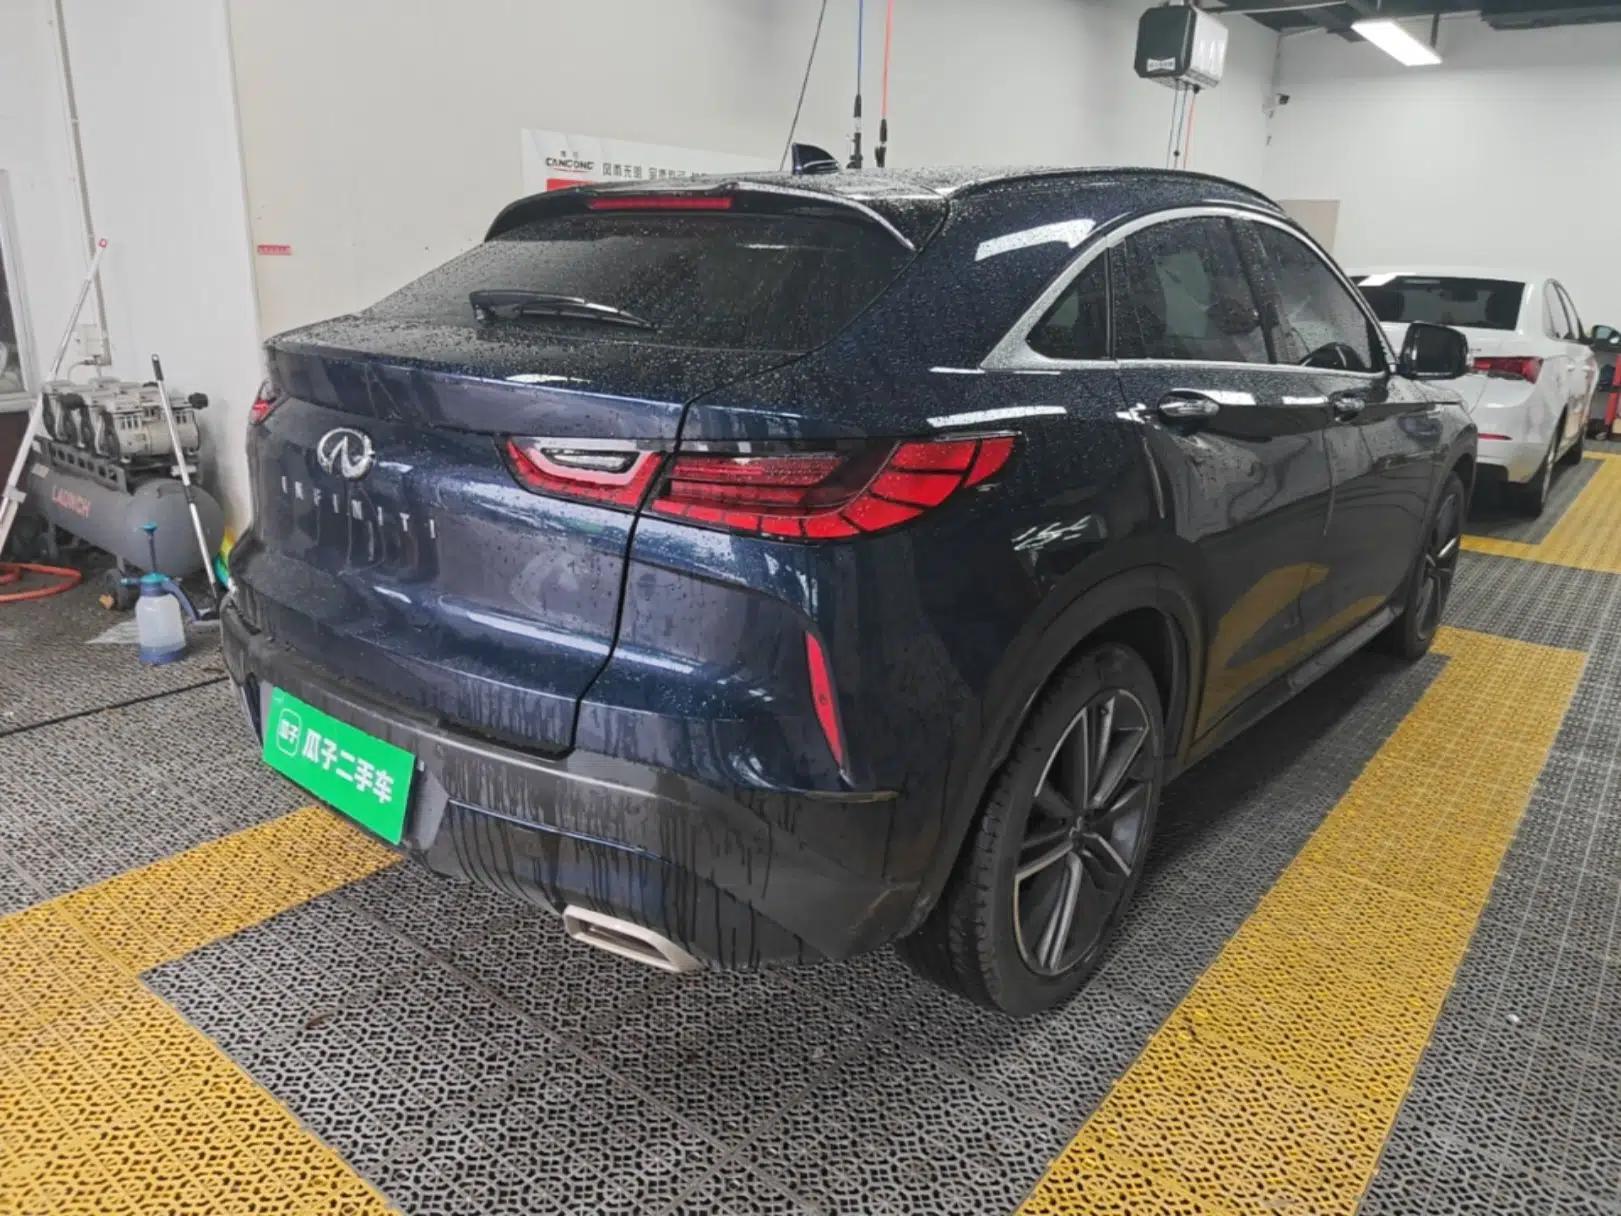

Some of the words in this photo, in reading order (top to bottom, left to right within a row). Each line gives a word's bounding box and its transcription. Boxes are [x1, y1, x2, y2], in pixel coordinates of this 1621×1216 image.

[281, 475, 435, 538] INFINITI
[302, 728, 394, 804] 瓜子二手车
